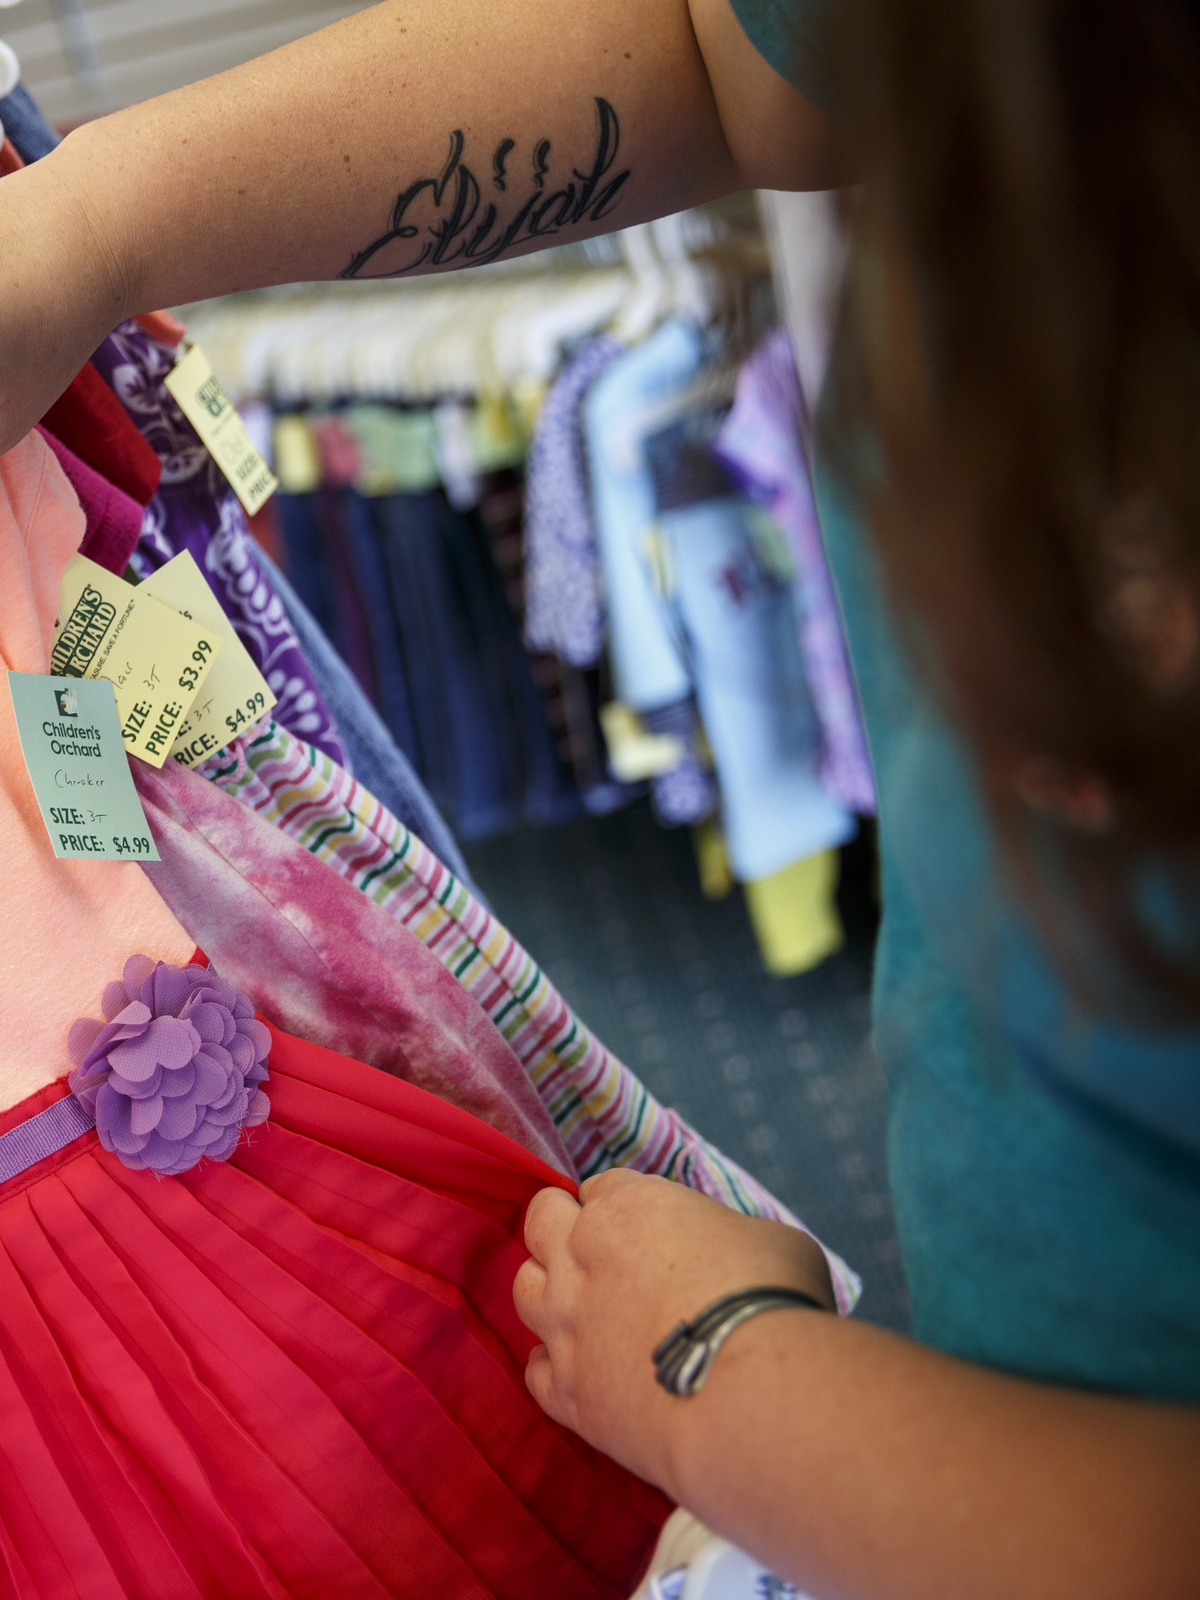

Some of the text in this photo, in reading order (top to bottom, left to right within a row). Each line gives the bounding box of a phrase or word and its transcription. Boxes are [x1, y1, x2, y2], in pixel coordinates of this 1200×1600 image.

[337, 96, 631, 278] Elijah
[103, 639, 116, 656] SAVE
[121, 663, 161, 742] SIZE: 3T
[145, 701, 183, 756] PRICE:
[178, 640, 213, 691] $3.99
[42, 721, 101, 740] Children's
[173, 733, 219, 766] RICE:
[225, 692, 265, 733] $4.99
[50, 740, 102, 757] Orchard
[50, 807, 108, 825] SIZE: 3T
[58, 834, 150, 855] PRICE: $4.99
